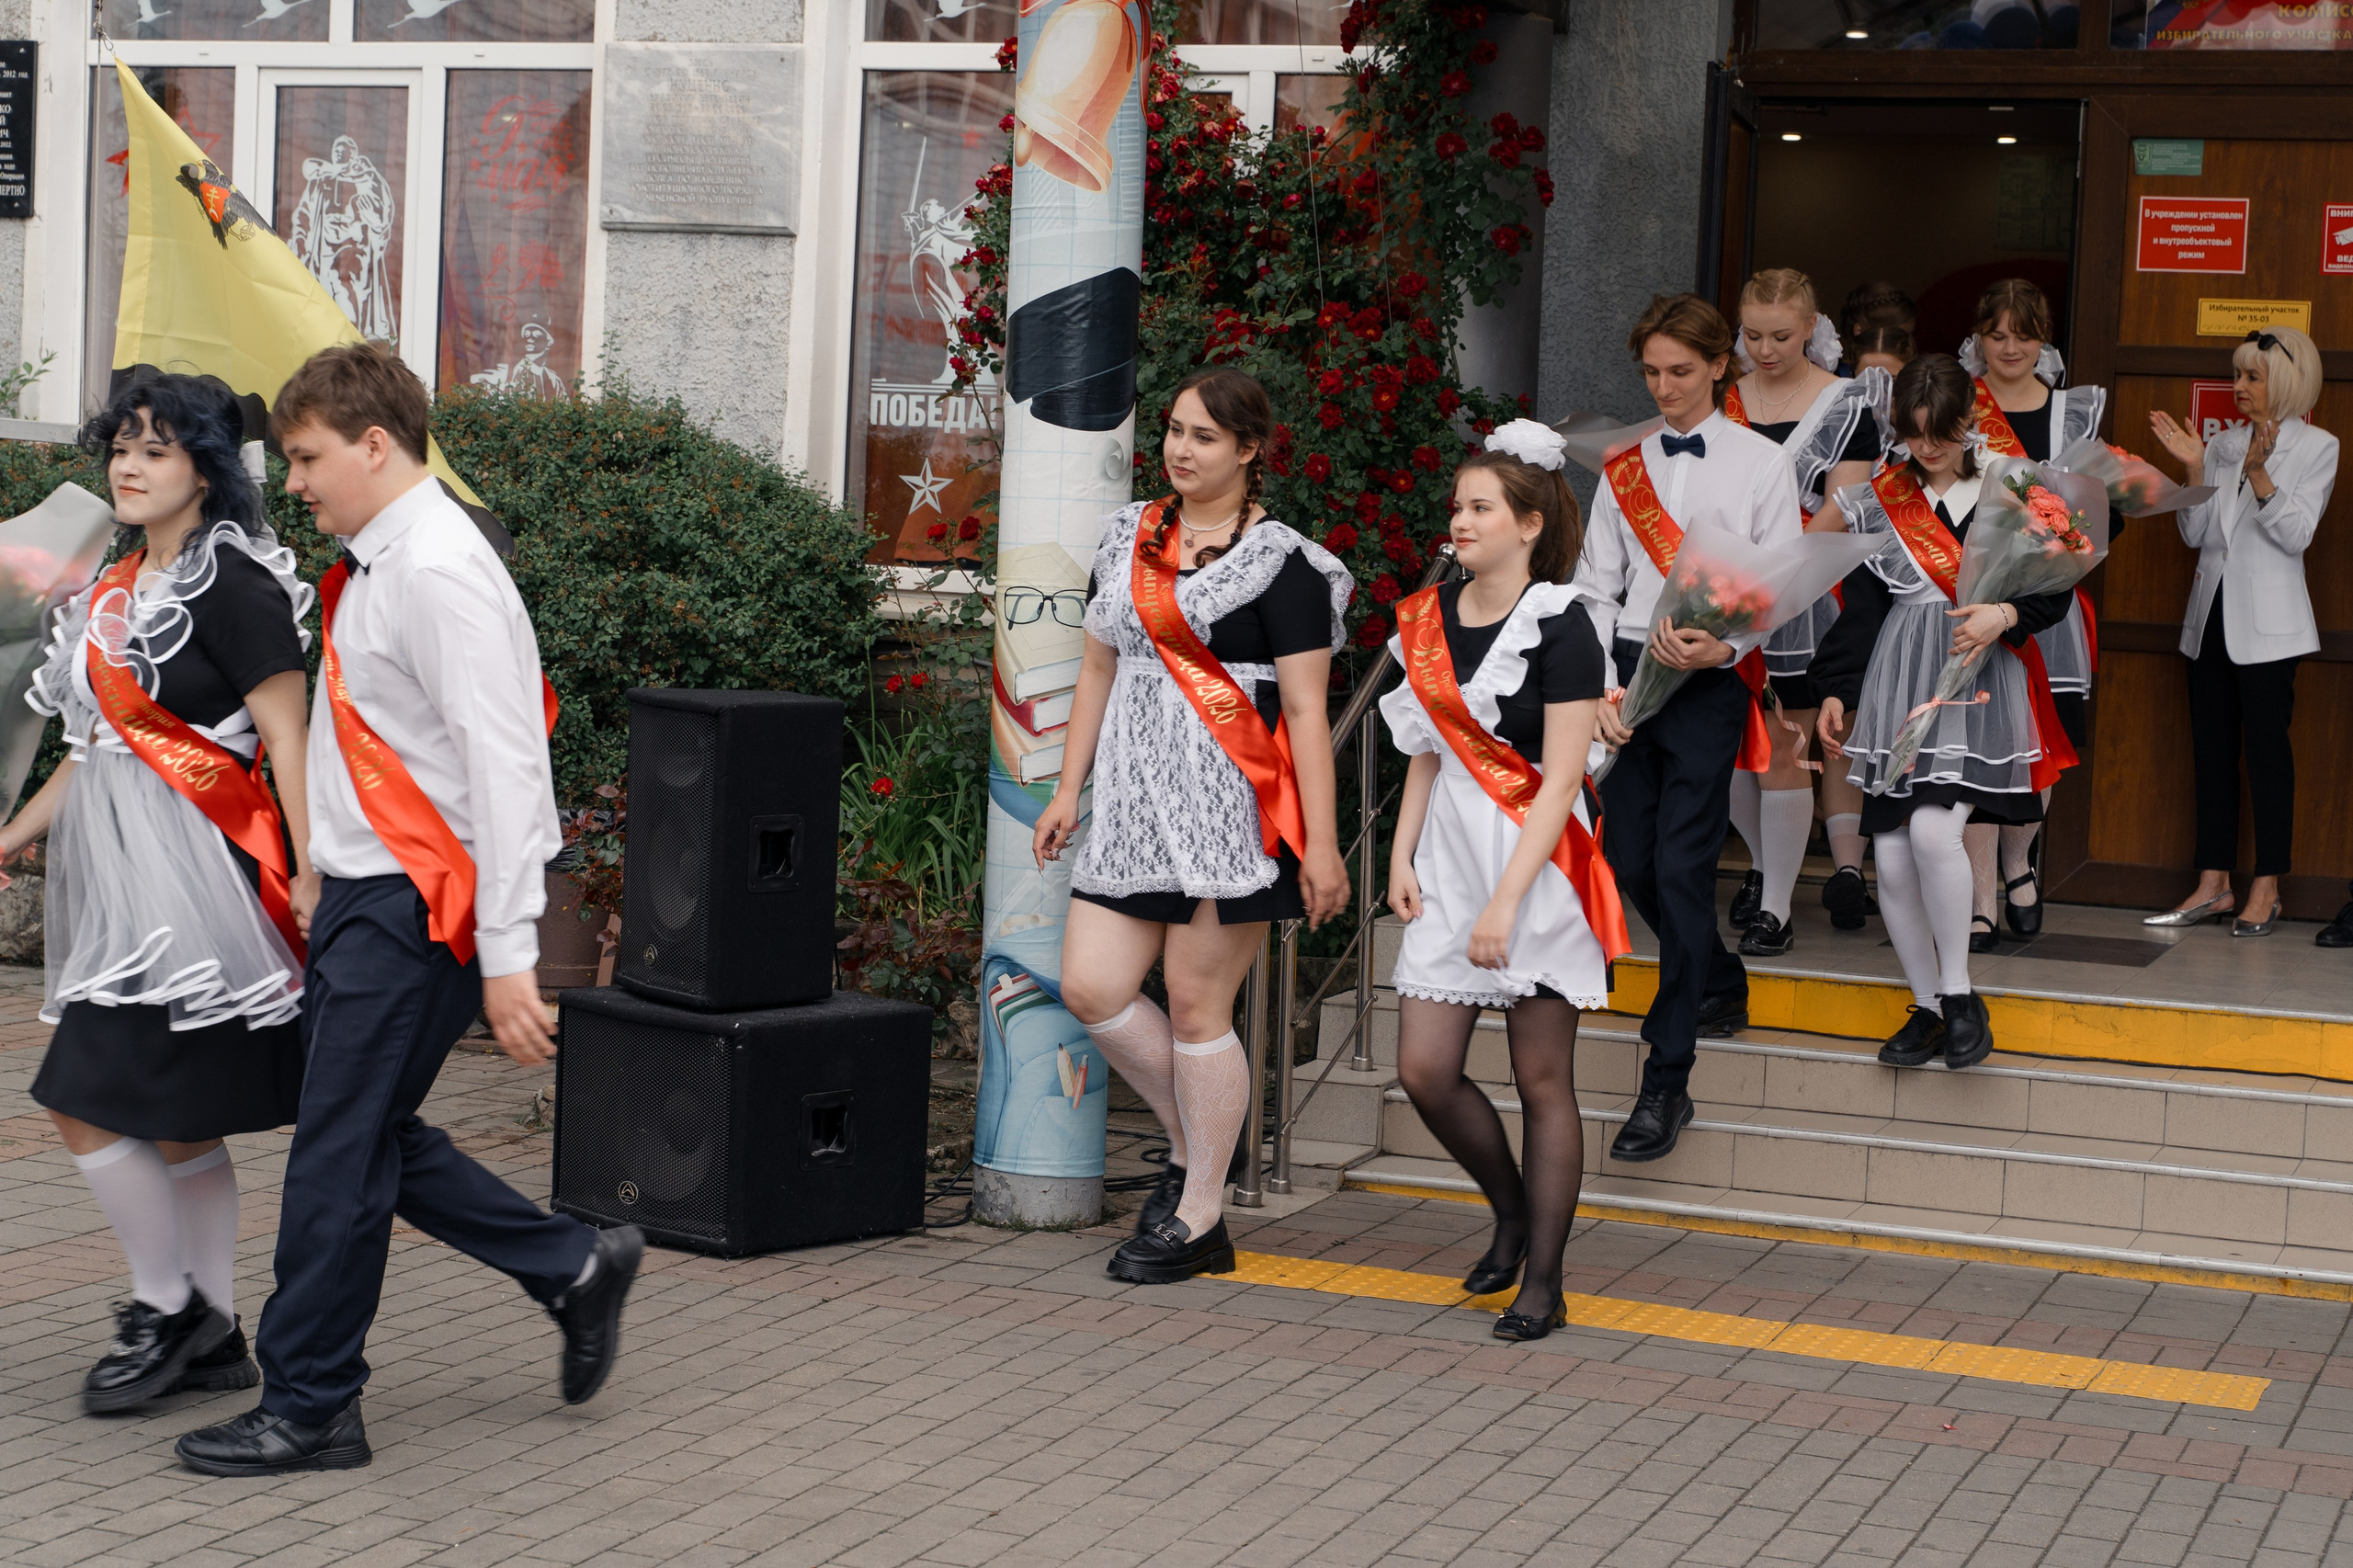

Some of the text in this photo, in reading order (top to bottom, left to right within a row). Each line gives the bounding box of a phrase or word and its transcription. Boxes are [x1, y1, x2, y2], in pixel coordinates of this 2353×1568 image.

[2279, 4, 2353, 18] КОМИС
[2156, 30, 2282, 40] ИЗБИРАТЕЛЬНОГО
[3, 69, 17, 78] 2012
[670, 79, 731, 93] КУЦЕНКО
[481, 95, 527, 160] 9
[2144, 209, 2244, 221] В учреждении установлен
[2330, 209, 2353, 218] ВНИ
[2171, 223, 2216, 233] пропускной
[2177, 251, 2205, 260] режим
[2209, 304, 2300, 315] Избирательный участок
[2248, 315, 2270, 324] 35-03
[870, 392, 997, 435] ПОБЕДА!
[1175, 622, 1201, 653] Дарья
[1193, 678, 1248, 724] 2026
[158, 739, 231, 791] 2026
[341, 732, 397, 790] 2026
[1498, 773, 1537, 819] 202
